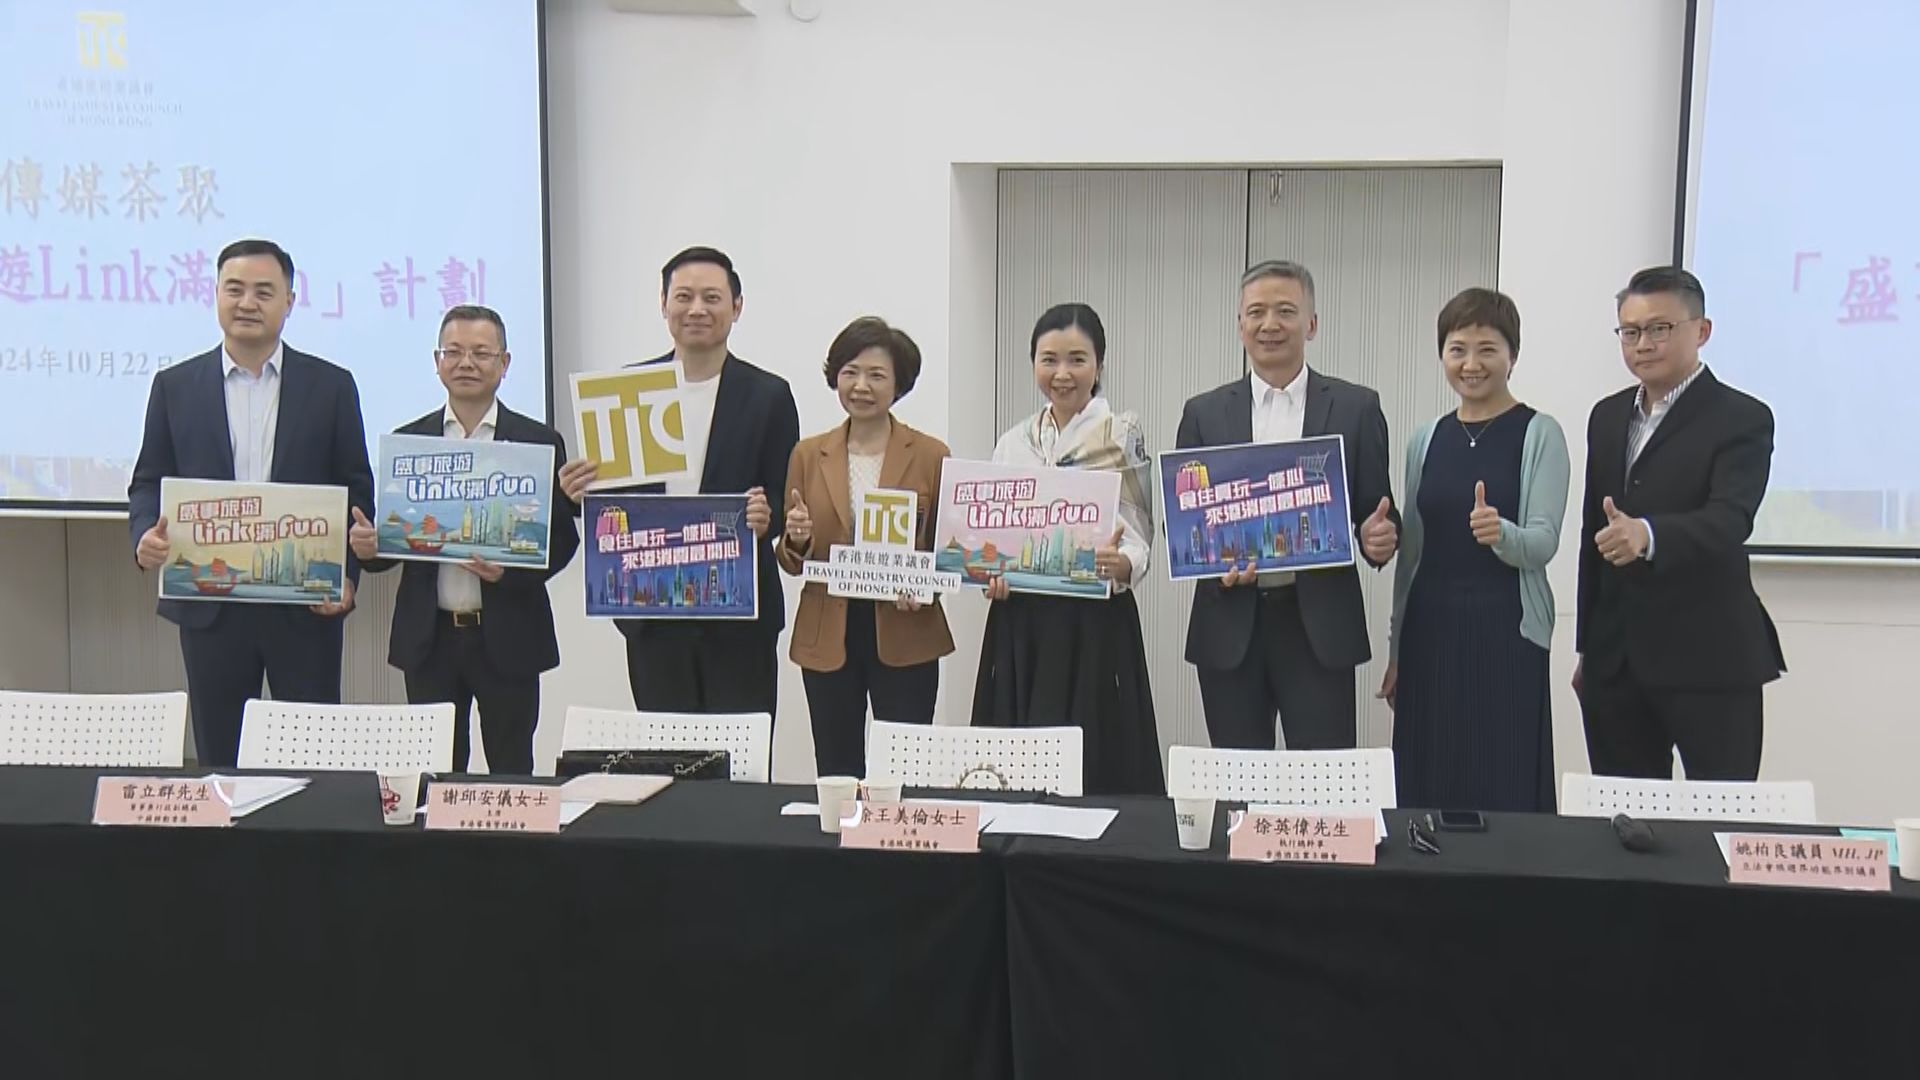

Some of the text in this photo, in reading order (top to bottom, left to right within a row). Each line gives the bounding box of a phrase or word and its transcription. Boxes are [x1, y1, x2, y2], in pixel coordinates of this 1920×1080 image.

[0, 156, 225, 223] 傳媒茶聚
[837, 550, 931, 569] 香港旅遊業議會
[806, 565, 957, 589] TRAVEL INDUSTRY COUNCIL
[837, 582, 925, 598] OF HONG KONG
[122, 783, 210, 801] 雷立群先生
[442, 789, 549, 808] 謝邱安儀女士
[1253, 817, 1350, 838] 徐英偉先生
[1735, 841, 1823, 860] 姚柏良議員
[1864, 847, 1884, 861] JP
